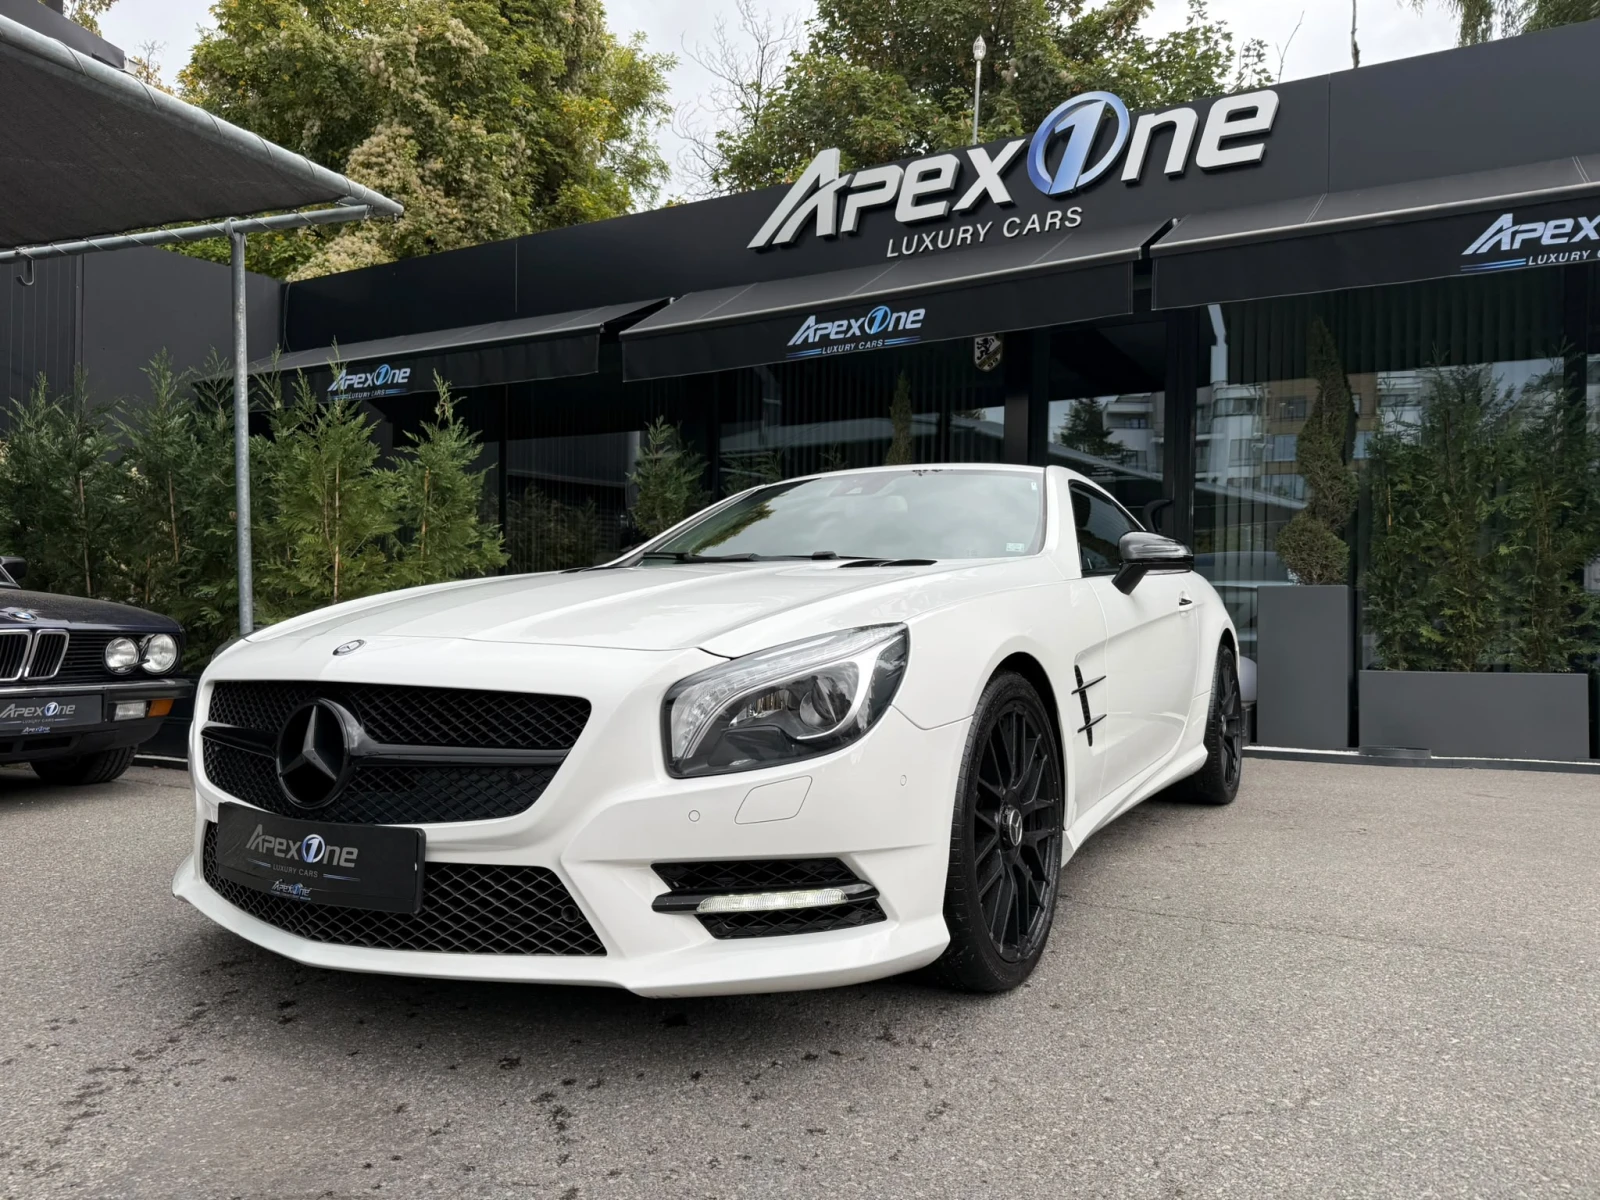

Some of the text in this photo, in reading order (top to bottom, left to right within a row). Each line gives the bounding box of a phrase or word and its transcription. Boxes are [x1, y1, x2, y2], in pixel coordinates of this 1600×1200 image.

[886, 206, 1083, 258] LUXURY CARS
[1528, 249, 1591, 265] LUXURY
[822, 339, 883, 354] LUXURY CARS
[272, 863, 319, 878] LUXURY CARS
